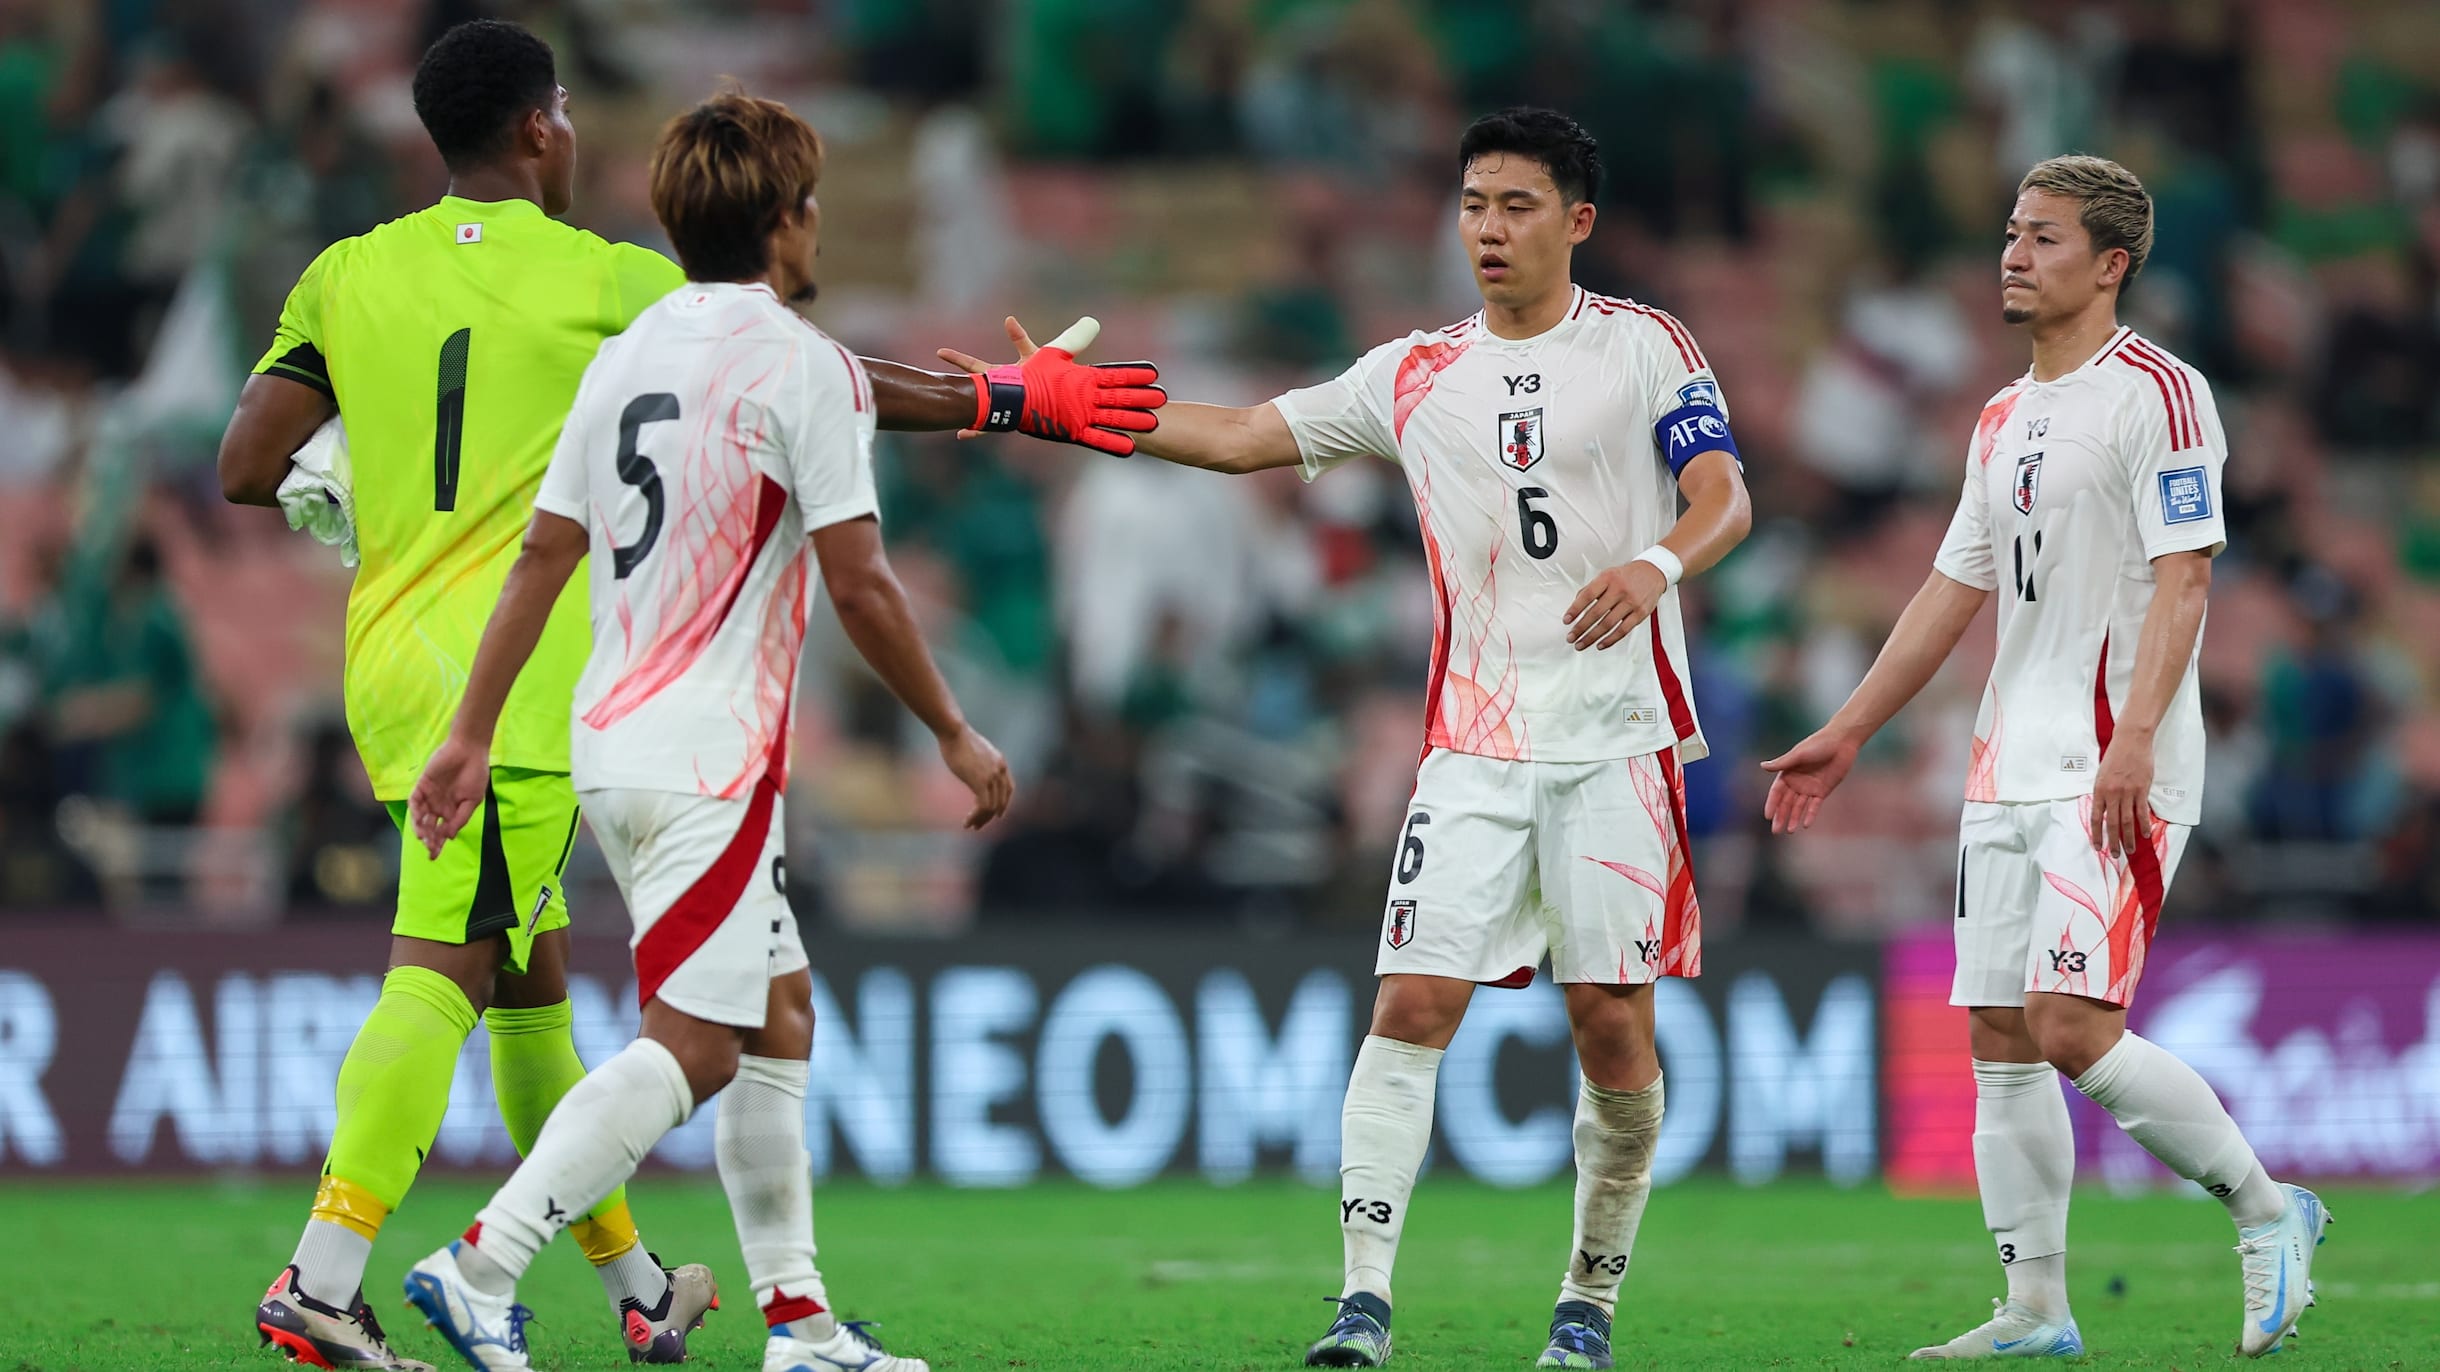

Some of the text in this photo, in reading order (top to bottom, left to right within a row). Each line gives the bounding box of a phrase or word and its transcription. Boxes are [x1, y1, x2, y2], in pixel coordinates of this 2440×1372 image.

[1502, 373, 1541, 396] Y-3
[435, 327, 470, 511] 1
[1509, 410, 1534, 420] JAPAN
[1668, 415, 1728, 460] AFC
[613, 392, 680, 579] 5
[2170, 484, 2199, 497] UNITES
[1518, 487, 1558, 559] 6
[1397, 812, 1431, 885] 6
[1634, 939, 1660, 962] Y-3
[2048, 949, 2087, 973] Y-3
[810, 964, 1876, 1188] NEOMCOM
[1341, 1199, 1392, 1224] Y-3
[1580, 1249, 1627, 1275] Y-3
